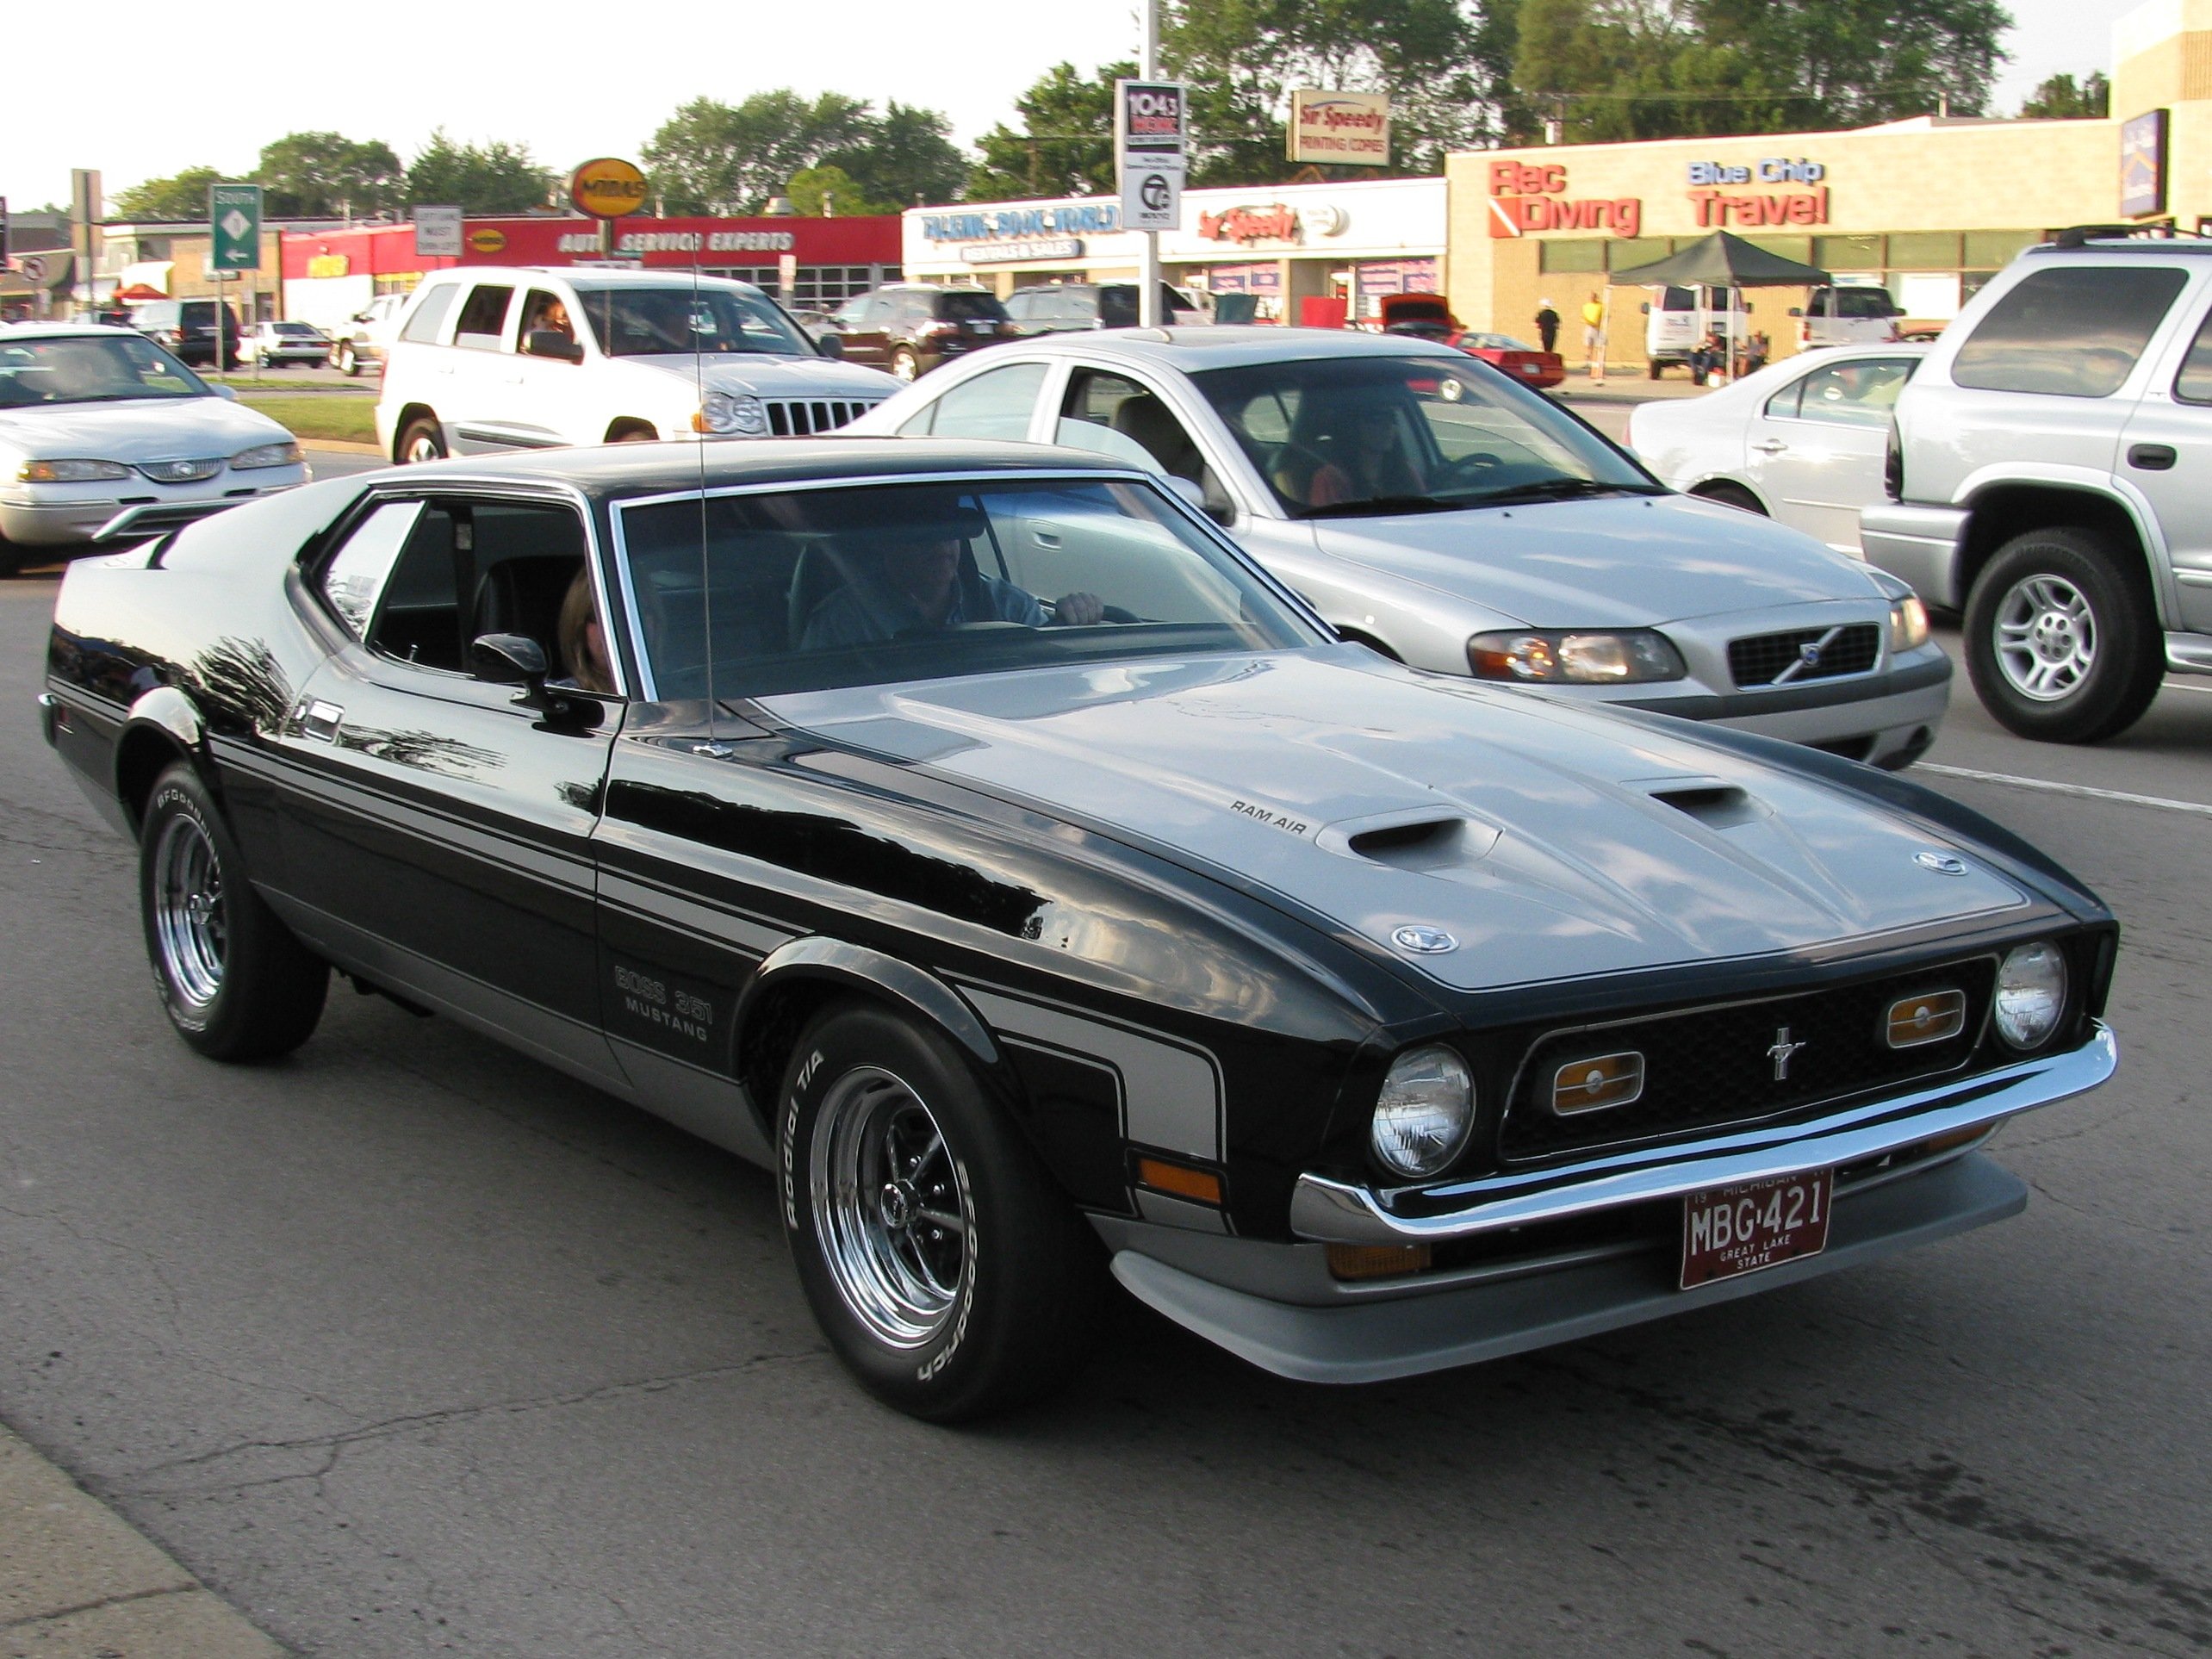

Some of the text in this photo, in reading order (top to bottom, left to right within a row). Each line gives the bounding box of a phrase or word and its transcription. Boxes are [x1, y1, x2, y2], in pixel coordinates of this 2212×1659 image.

[1300, 104, 1385, 134] Sir Speedy
[1300, 134, 1386, 153] PRINTING COPIES
[1489, 160, 1566, 196] Rec
[1688, 157, 1824, 185] Blue Chip
[1519, 196, 1641, 239] Diving
[1687, 186, 1829, 227] Travel
[558, 232, 795, 252] AUT SERVICE EXPERTS
[1230, 800, 1308, 835] RAM AIR
[614, 965, 713, 1025] BOSS 351
[624, 996, 708, 1042] MUSTANG
[796, 1048, 825, 1092] T/A
[1720, 1233, 1792, 1262] GREAT LAKE
[1737, 1251, 1771, 1270] STATE
